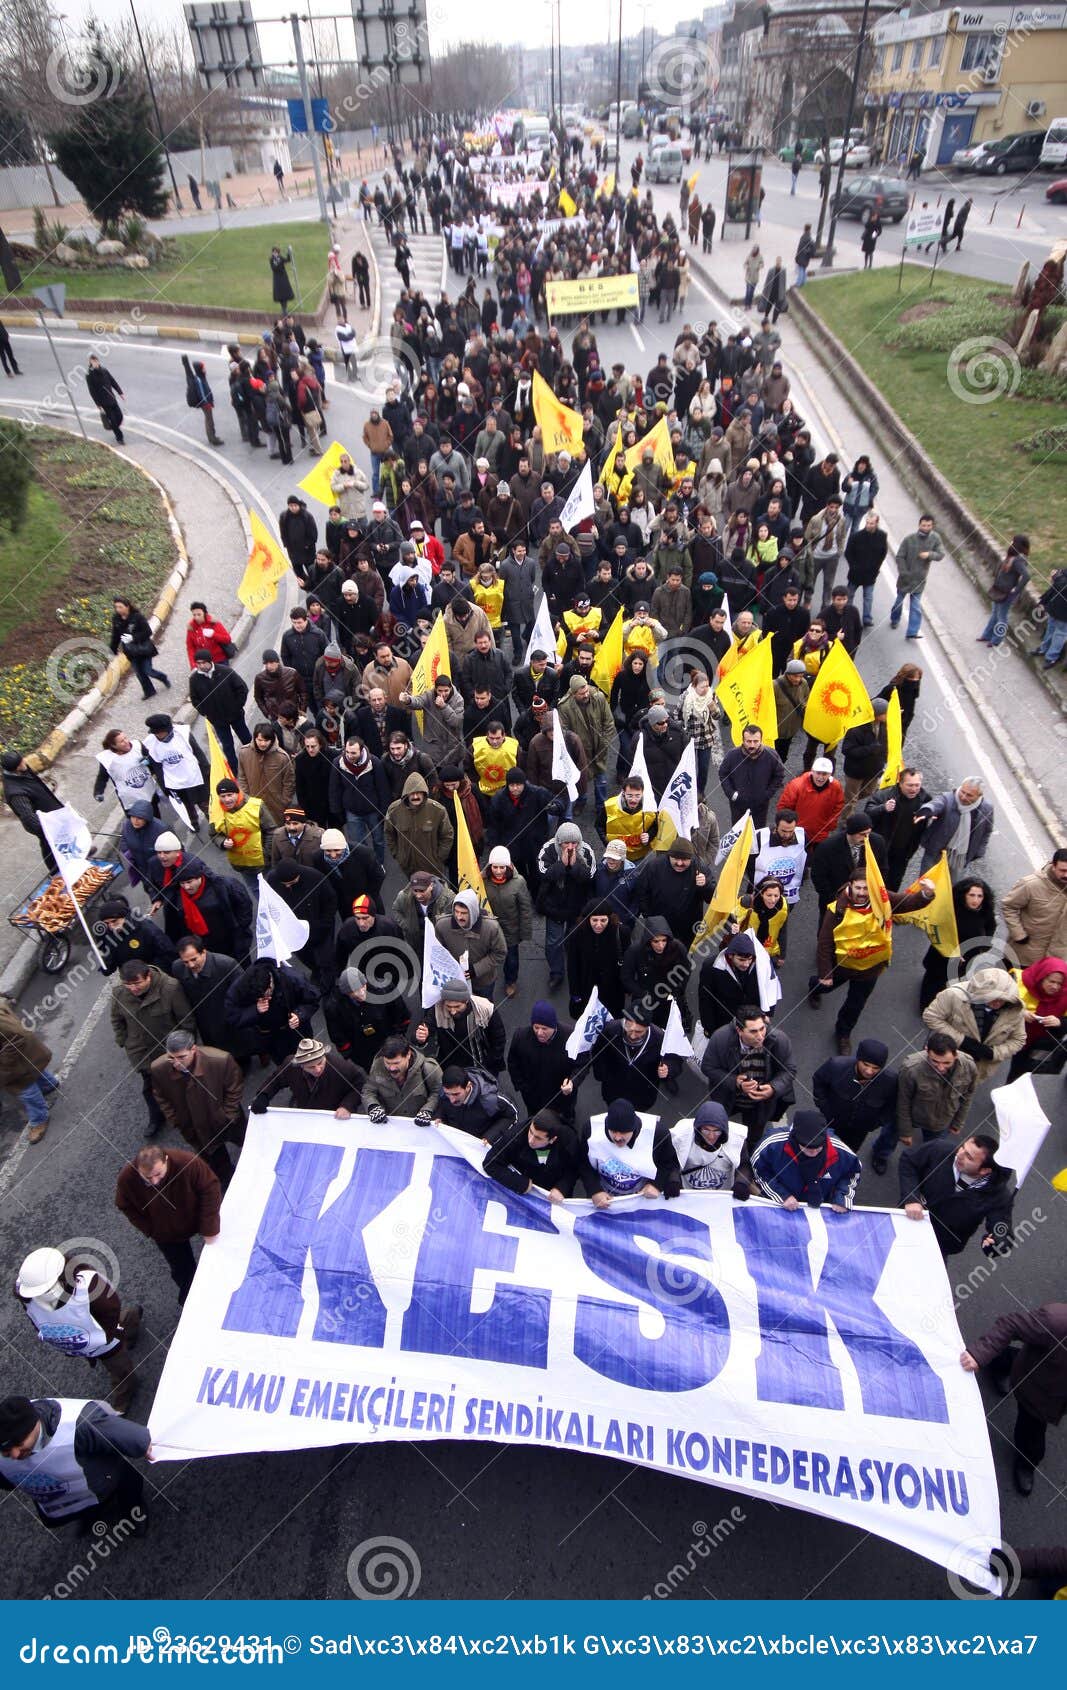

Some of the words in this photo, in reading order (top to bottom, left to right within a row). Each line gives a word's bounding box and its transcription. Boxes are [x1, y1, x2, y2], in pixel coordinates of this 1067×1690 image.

[222, 1140, 949, 1425] KESK
[195, 1366, 286, 1415] KAMU
[290, 1376, 457, 1434] EMEKÇİLERİ
[464, 1395, 654, 1461] SENDİKALARI
[666, 1427, 971, 1516] KONFEDERASYONU
